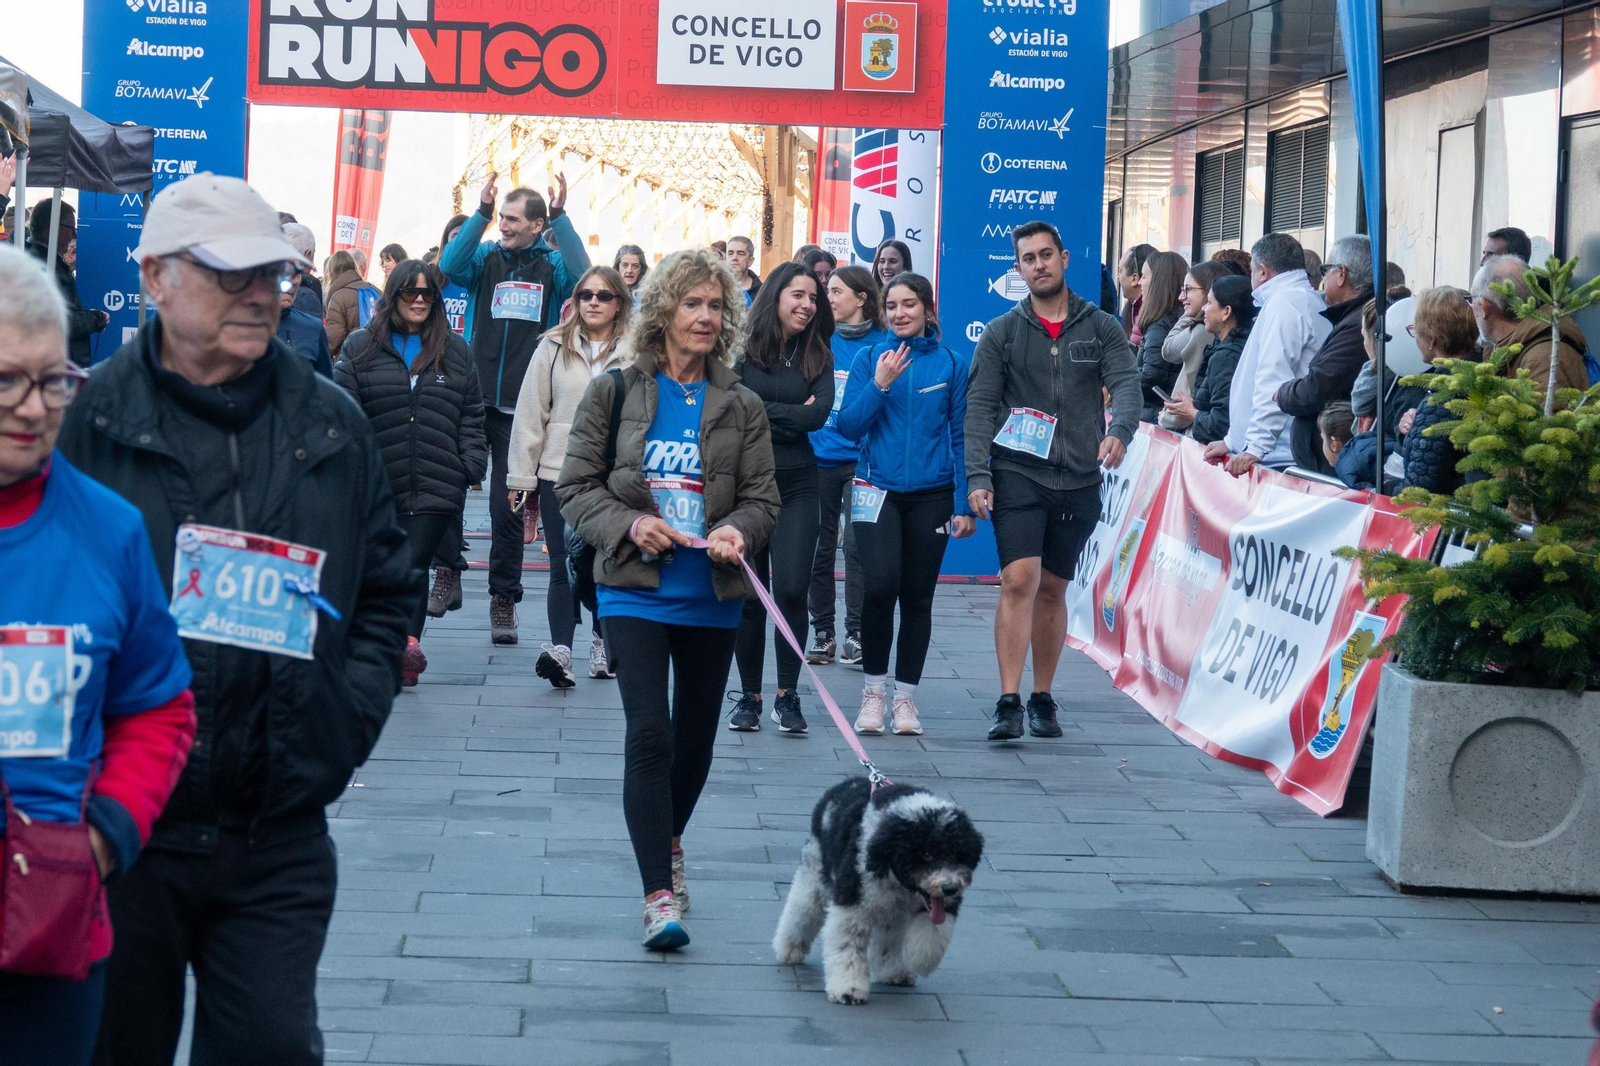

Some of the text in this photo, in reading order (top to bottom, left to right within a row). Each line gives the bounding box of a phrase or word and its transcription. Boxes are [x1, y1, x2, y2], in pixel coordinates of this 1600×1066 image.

[146, 16, 177, 25] ESTACIÓN
[190, 18, 207, 26] VIGO
[672, 14, 821, 41] CONCELLO
[1009, 28, 1069, 46] vialia
[126, 38, 205, 60] Alcampo
[689, 43, 803, 68] DE VIGO
[1008, 49, 1039, 57] ESTACIÓN
[1051, 50, 1068, 58] VIGO
[117, 79, 141, 87] GRUPO
[989, 70, 1066, 92] Alcampo
[115, 86, 188, 100] BOTAMAVI
[977, 118, 1048, 131] BOTAMAVI
[1004, 159, 1068, 170] COTERENA
[989, 189, 1040, 204] FIATC
[988, 203, 1056, 211] SEGUROS
[502, 291, 537, 308] 6055
[1074, 346, 1096, 358] 117
[201, 611, 287, 645] Alcampo
[1208, 616, 1256, 684] DE
[1243, 629, 1300, 705] VIGO
